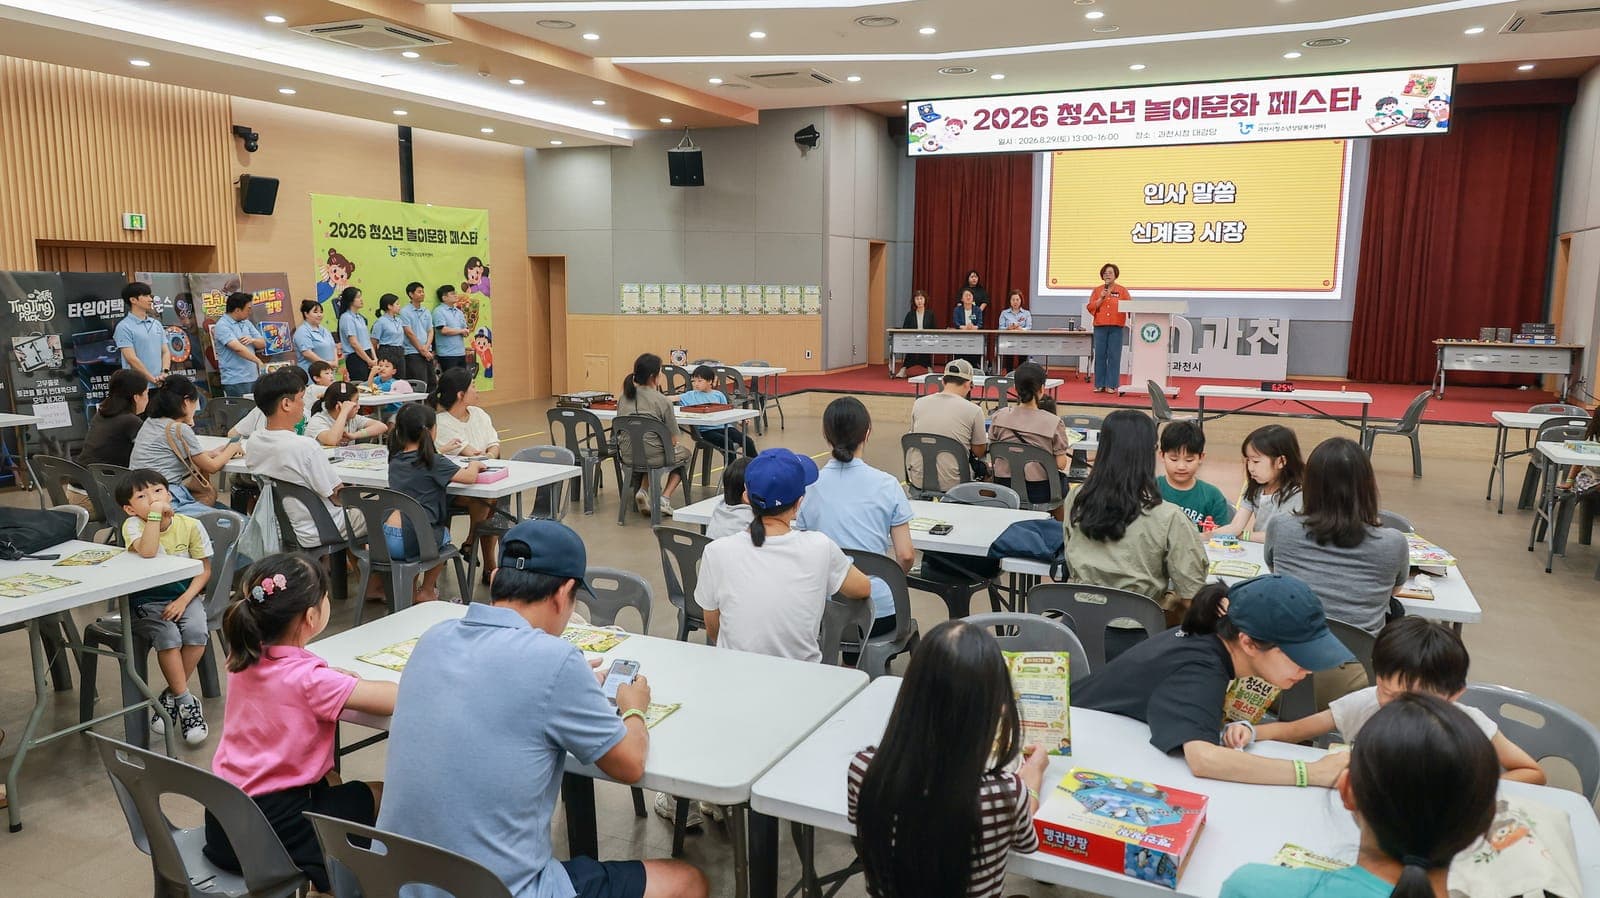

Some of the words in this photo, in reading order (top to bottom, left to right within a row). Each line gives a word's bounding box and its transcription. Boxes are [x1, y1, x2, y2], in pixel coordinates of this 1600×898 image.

[973, 105, 1049, 131] 2026
[1057, 100, 1136, 126] 청소년
[1145, 93, 1260, 122] 놀이문화
[1267, 87, 1362, 115] 페스타
[998, 138, 1013, 146] 일시
[1135, 131, 1151, 140] 장소
[1157, 128, 1190, 139] 과천시청
[1192, 127, 1217, 138] 대강당
[1143, 182, 1188, 205] 인사
[1192, 181, 1237, 204] 말씀
[329, 222, 367, 240] 2026
[369, 223, 404, 241] 청소년
[406, 227, 447, 245] 놀이문화
[450, 230, 479, 246] 페스타
[1130, 221, 1195, 243] 신계용
[1199, 220, 1247, 243] 시장
[67, 298, 125, 318] 타임어택
[1199, 316, 1289, 356] 과천
[1172, 361, 1201, 372] 과천시
[1246, 676, 1273, 697] 청소년
